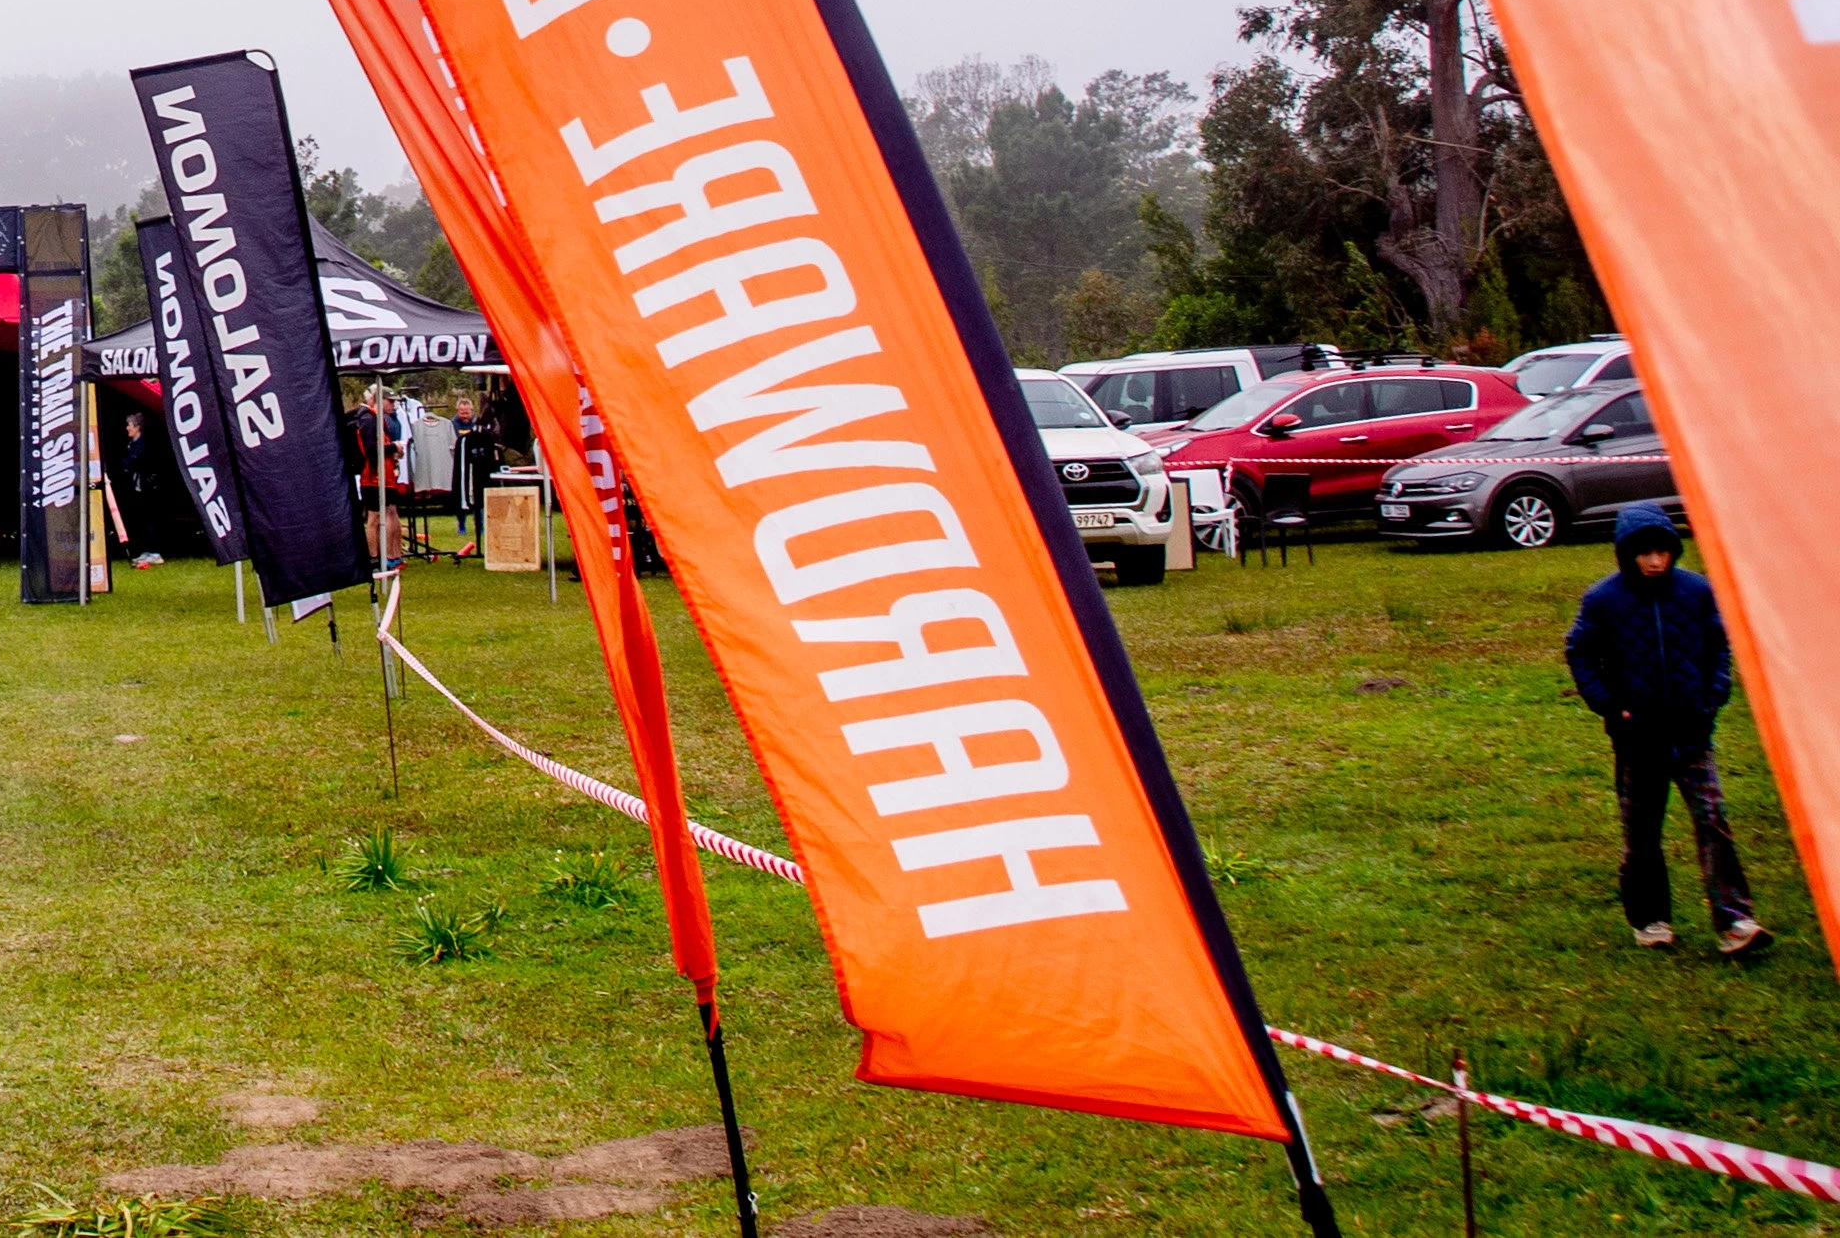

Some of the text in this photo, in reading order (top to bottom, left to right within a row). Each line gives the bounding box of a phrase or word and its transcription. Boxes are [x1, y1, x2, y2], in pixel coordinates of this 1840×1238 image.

[41, 299, 74, 361] THE
[332, 334, 488, 368] LOMON
[31, 317, 41, 508] PLETTENBERG BAY
[41, 352, 74, 439] TRAIL
[41, 432, 76, 508] SHOP
